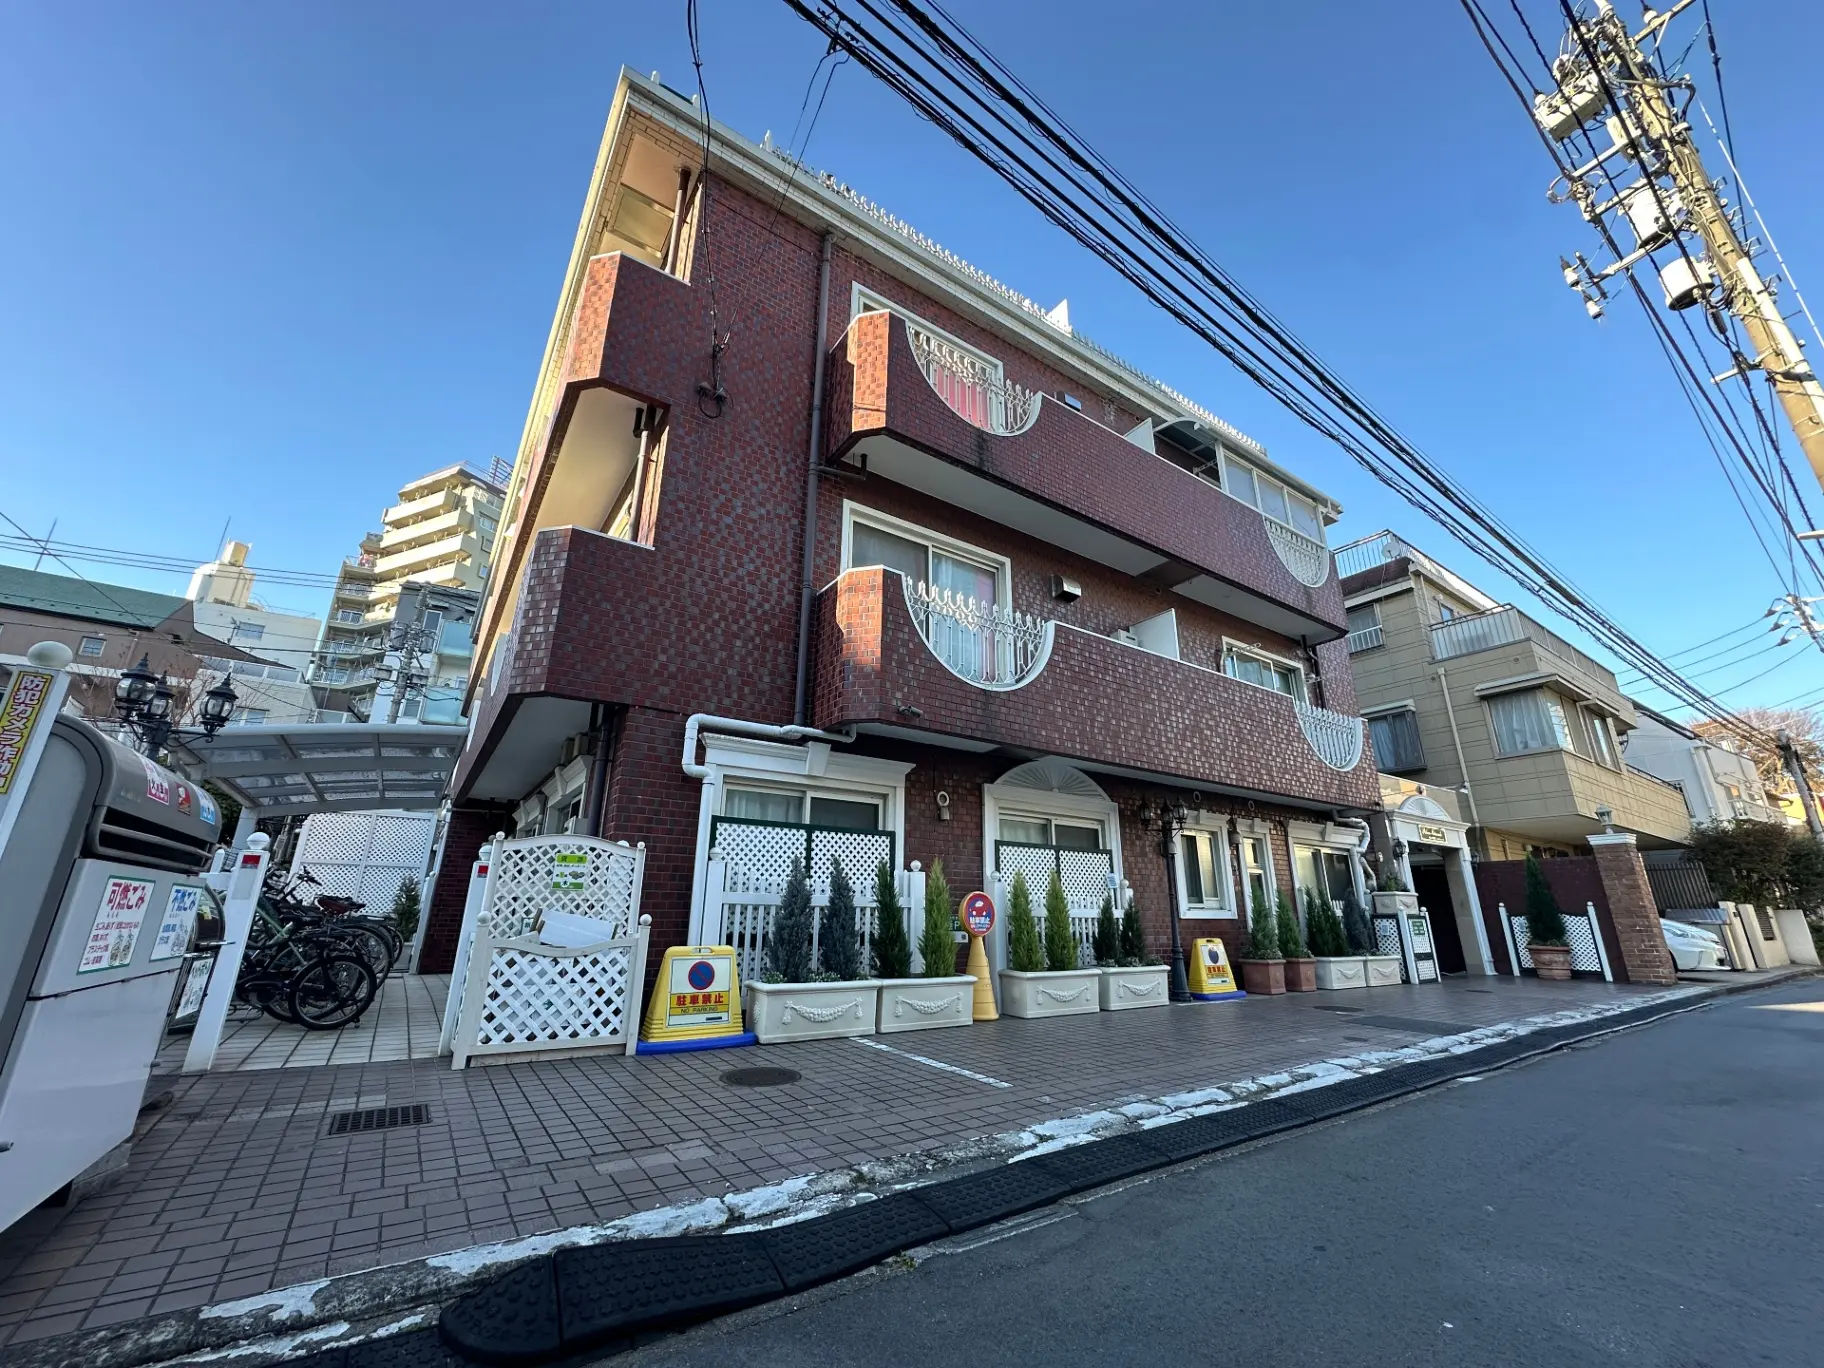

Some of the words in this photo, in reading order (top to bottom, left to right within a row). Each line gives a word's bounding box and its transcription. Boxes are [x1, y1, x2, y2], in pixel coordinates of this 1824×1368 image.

[107, 882, 147, 911] 可燃ごみ
[171, 888, 197, 912] 不燃ごみ
[676, 993, 724, 1006] 駐車禁止
